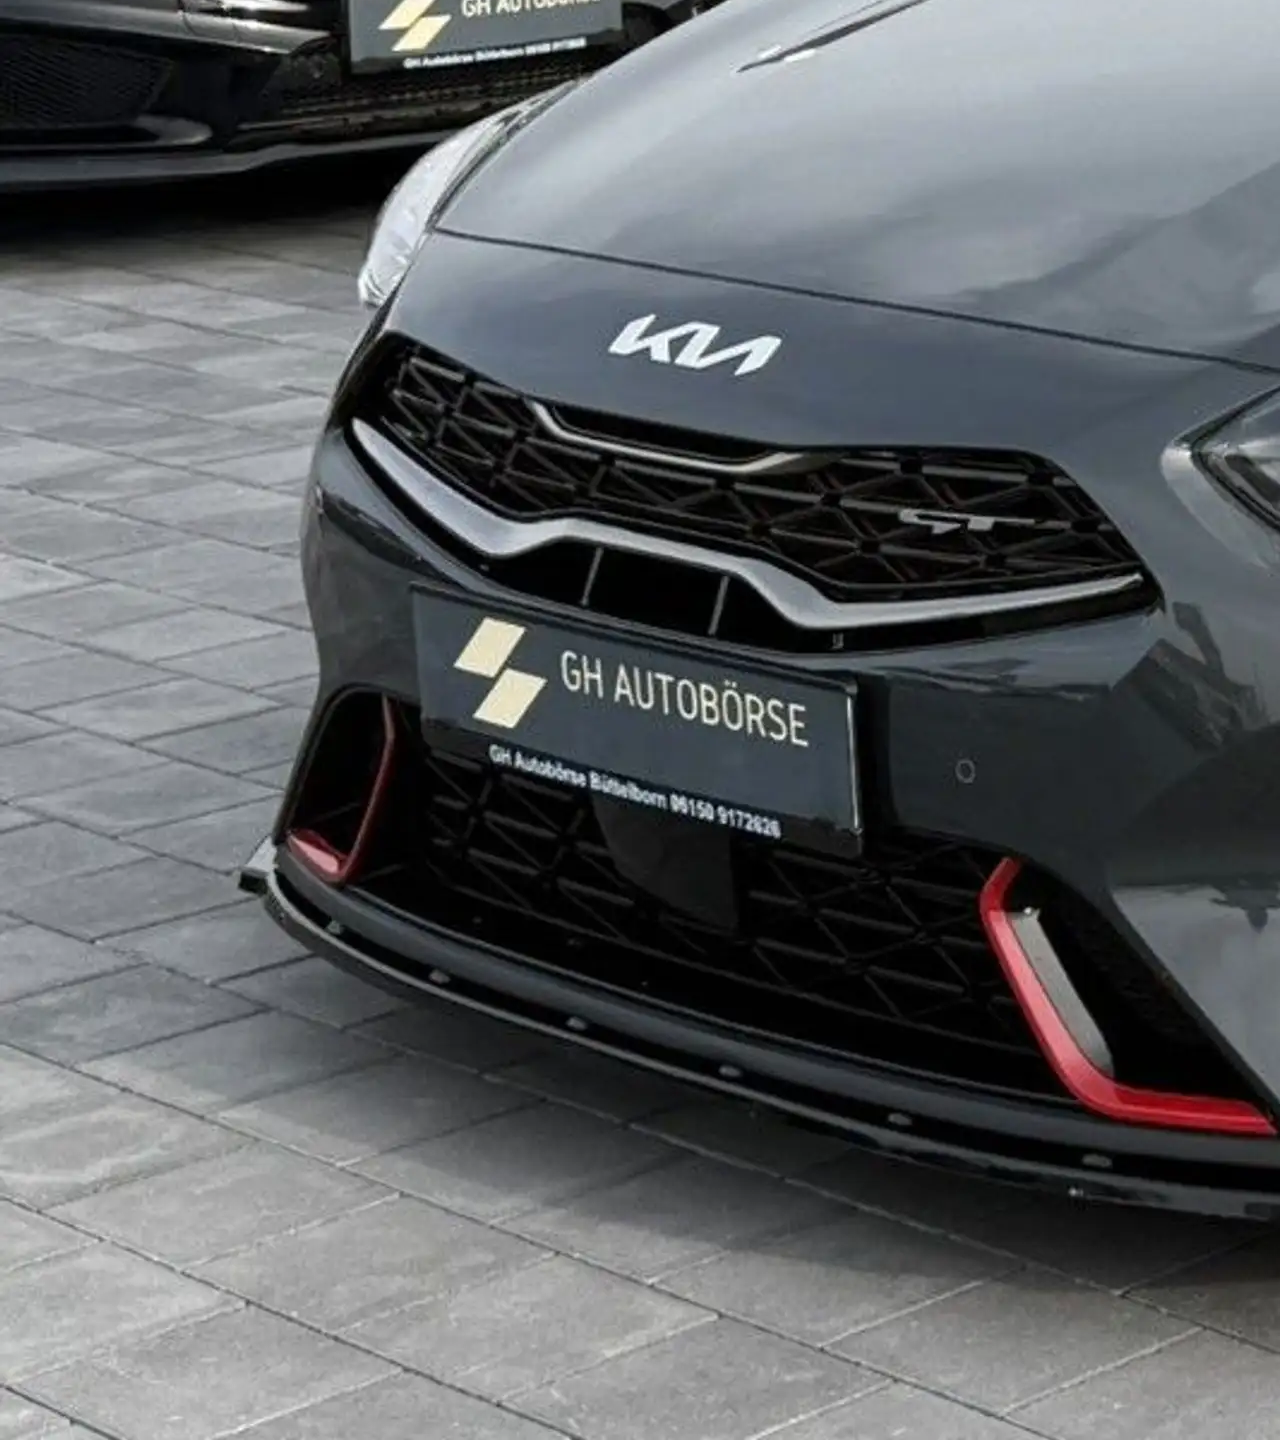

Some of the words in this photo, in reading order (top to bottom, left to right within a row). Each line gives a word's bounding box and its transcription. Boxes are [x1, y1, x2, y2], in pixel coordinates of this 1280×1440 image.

[607, 313, 783, 377] KIA
[560, 650, 605, 699] GH
[613, 663, 811, 748] AUTOBÖRSE
[489, 743, 513, 766] GH
[514, 750, 588, 789] Autobörse
[589, 770, 668, 811] Büttelborn
